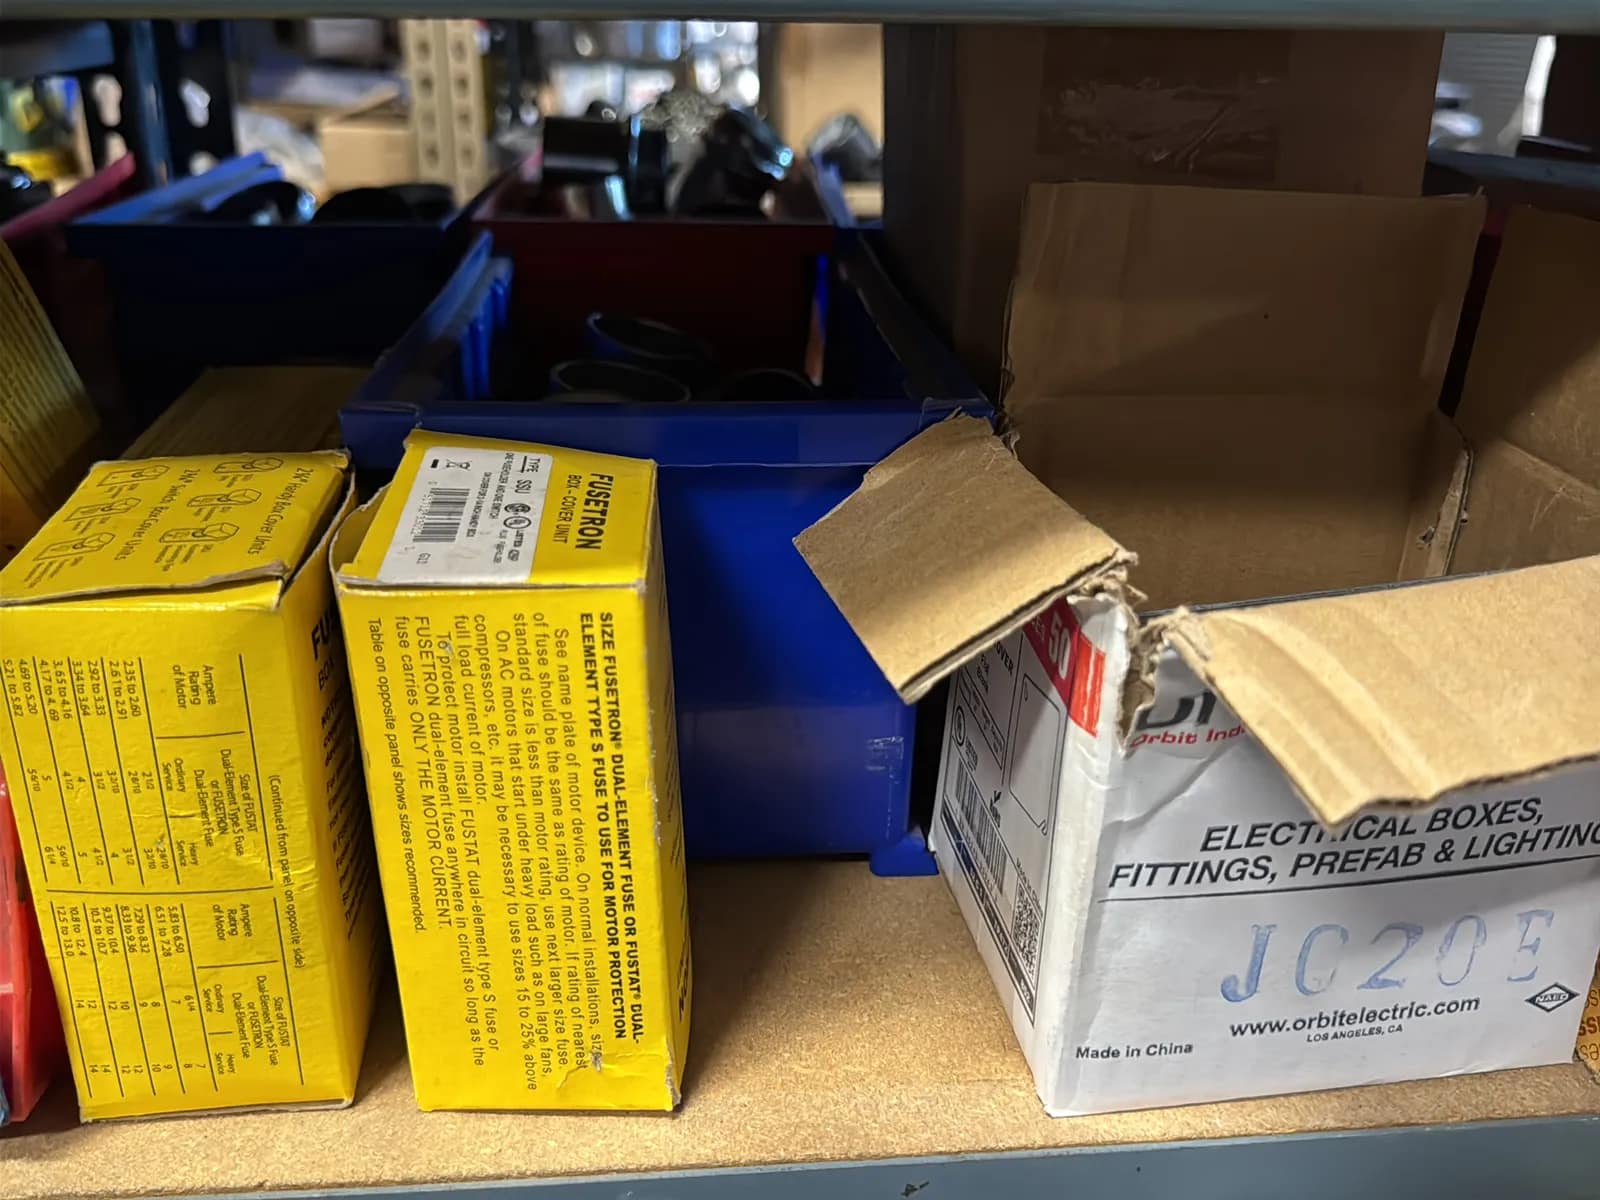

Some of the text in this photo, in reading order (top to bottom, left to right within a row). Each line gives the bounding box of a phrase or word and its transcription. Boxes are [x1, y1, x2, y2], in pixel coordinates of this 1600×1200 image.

[159, 484, 187, 505] Switch
[279, 482, 298, 502] Handy
[513, 457, 541, 495] TYPE SSU
[565, 474, 583, 489] BOX
[133, 516, 158, 538] Cover
[152, 505, 170, 516] Box
[260, 514, 284, 534] Cover
[271, 500, 292, 514] Box
[557, 495, 578, 522] COVER
[575, 473, 614, 550] FUSETRON
[113, 538, 143, 561] Units
[247, 534, 273, 555] Units
[553, 524, 571, 544] UNIT
[553, 628, 570, 659] See
[599, 611, 616, 651] SIZE
[1049, 611, 1071, 681] 50
[172, 664, 187, 709] of Motor
[187, 670, 202, 706] Rating
[202, 664, 217, 705] Ampere
[557, 664, 572, 706] name
[454, 614, 489, 805] full load current of motor.
[558, 711, 577, 748] plate
[1130, 724, 1246, 748] Orbit Ind
[161, 762, 174, 792] Service
[173, 757, 186, 793] Ordinary
[367, 617, 428, 931] Table on opposite panel shows sizes recommended.
[394, 615, 453, 929] fuse carries ONLY THE MOTOR CURRENT.
[565, 752, 581, 768] of
[193, 768, 215, 848] Dual-Element Fuse
[209, 779, 230, 837] or FUSETRON
[220, 748, 245, 857] Dual-Element Type S Fuse
[238, 773, 259, 833] Size of FUSTAT
[567, 771, 583, 814] motor
[610, 753, 633, 871] DUAL-ELEMENT
[579, 612, 627, 1040] ELEMENT TYPE S FUSE TO USE FOR MOTOR PROTECTION
[1425, 797, 1544, 833] BOXES,
[175, 839, 188, 867] Service
[188, 842, 199, 866] Heavy
[414, 616, 486, 1066] FUSETRON dual-element fuse anywhere in circuit so long as the
[531, 612, 590, 1072] of fuse should be the same as rating of motor. If rating of nearest
[571, 817, 586, 868] device.
[267, 774, 306, 969] (Continued from panel on opposite side)
[575, 872, 591, 893] On
[1108, 855, 1278, 889] FITTINGS,
[1289, 842, 1426, 878] PREFAB
[1434, 838, 1456, 863] &
[619, 873, 636, 913] FUSE
[56, 905, 76, 957] 12.5 to 13.0
[69, 906, 88, 956] 10.8 to 12.4
[90, 907, 108, 956] 10.5 to 10.7
[101, 906, 120, 955] 9.37 to 10.4
[119, 905, 138, 954] 8.33 to 9.36
[133, 907, 151, 954] 7.29 to 8.32
[154, 905, 173, 958] 6.51 to 7.28
[167, 906, 185, 954] 5.83 to 6.50
[578, 897, 597, 943] normal
[623, 915, 638, 938] OR
[583, 947, 602, 1030] installations,
[629, 1002, 645, 1045] DUAL-
[1230, 996, 1481, 1037] www.orbitelectric.com
[1306, 1023, 1404, 1043] LOS ANGELES, CA
[1076, 1042, 1194, 1060] Made in China
